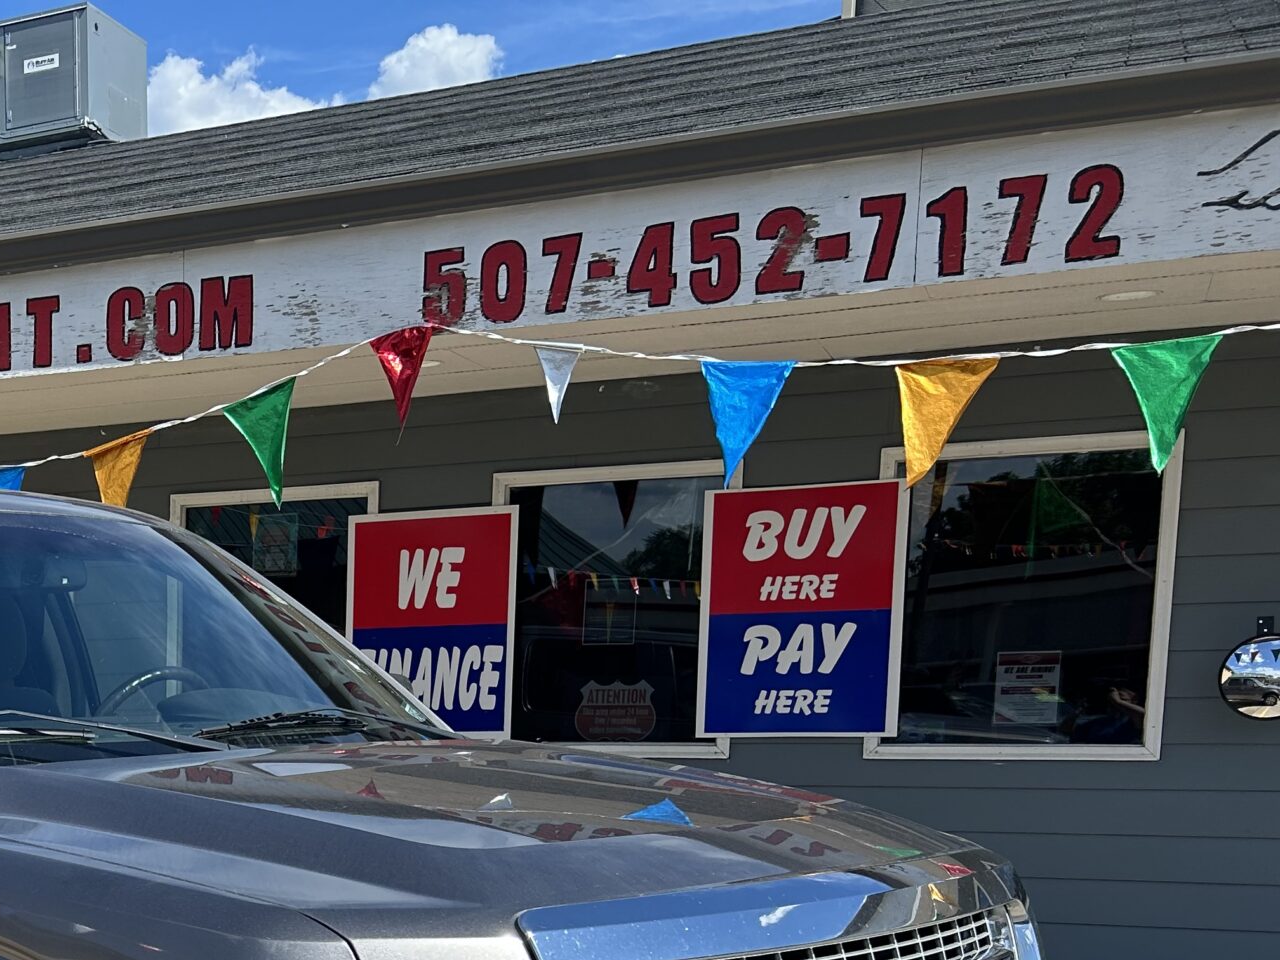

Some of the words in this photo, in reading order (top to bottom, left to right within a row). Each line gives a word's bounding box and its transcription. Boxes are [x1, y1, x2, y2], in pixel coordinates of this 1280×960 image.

[421, 163, 1124, 327] 507-452-7172
[742, 503, 867, 562] BUY
[398, 546, 465, 610] WE
[759, 573, 839, 602] HERE
[740, 621, 857, 676] PAY
[359, 644, 504, 711] ANCE
[586, 688, 647, 705] ATTENTION
[754, 688, 833, 716] HERE
